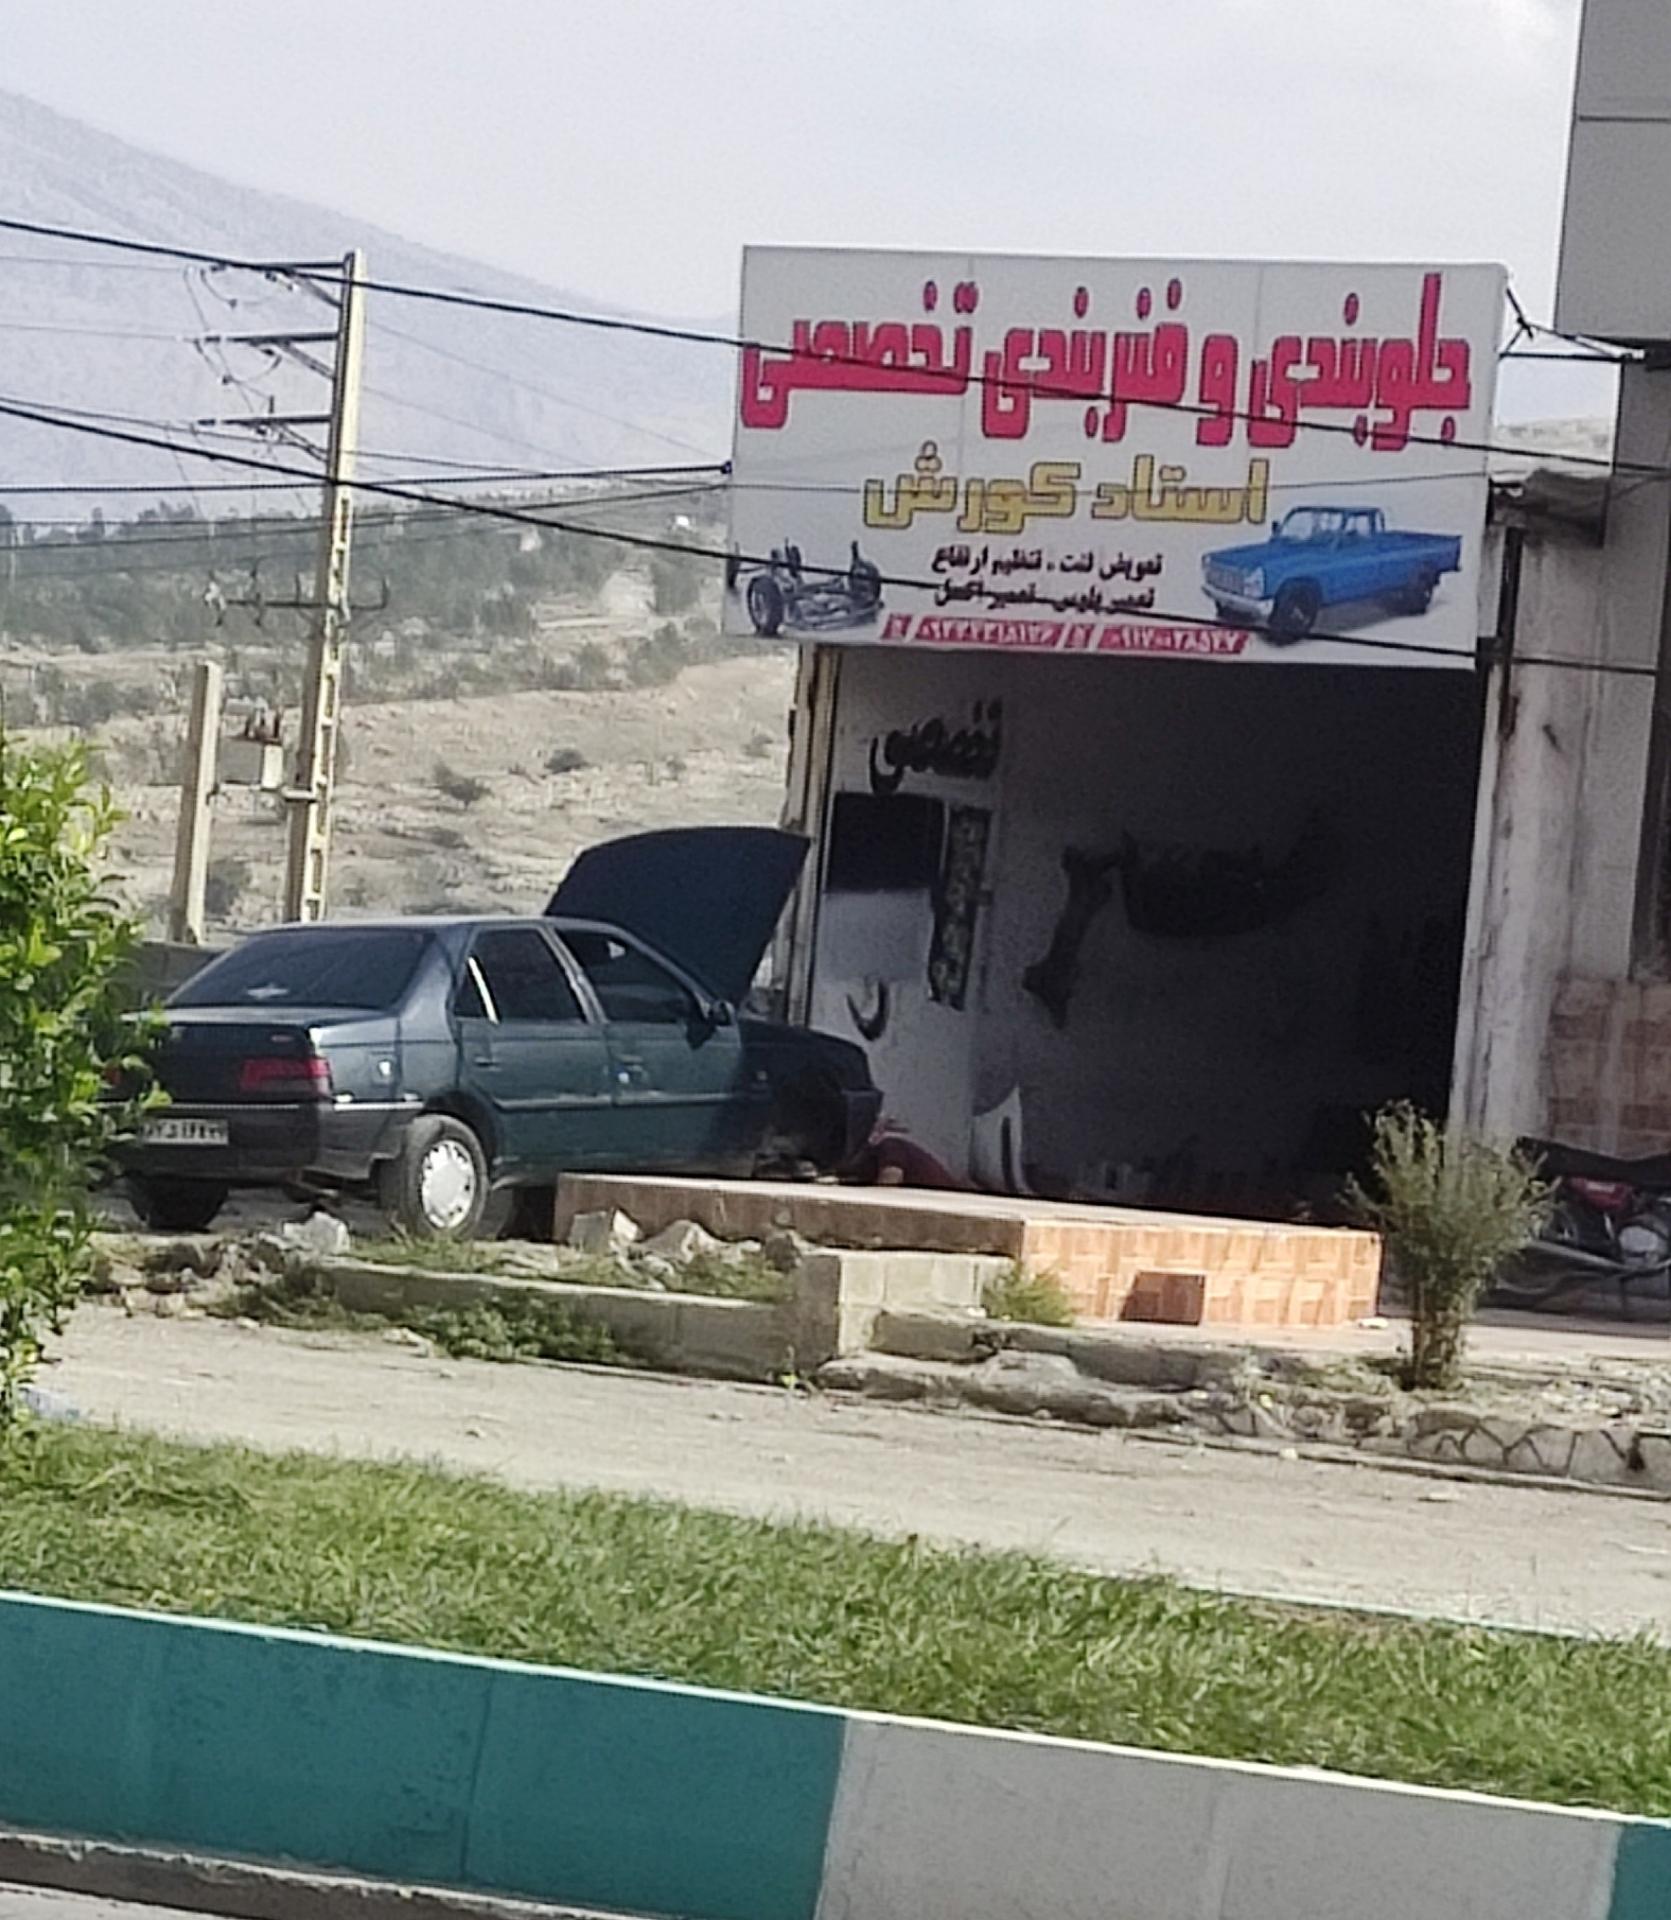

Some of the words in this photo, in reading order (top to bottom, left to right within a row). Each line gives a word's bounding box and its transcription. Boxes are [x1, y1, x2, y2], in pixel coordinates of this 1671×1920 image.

[740, 280, 978, 429] تخصصی
[982, 277, 1189, 443] فنربندی
[1195, 333, 1239, 447] و
[1247, 272, 1470, 451] جلوبندی
[863, 440, 1081, 533] کورش
[1091, 453, 1270, 524] استاد
[931, 544, 989, 576] ارتفاع
[991, 547, 1043, 575] تنظیم
[1099, 551, 1164, 581] تعویض
